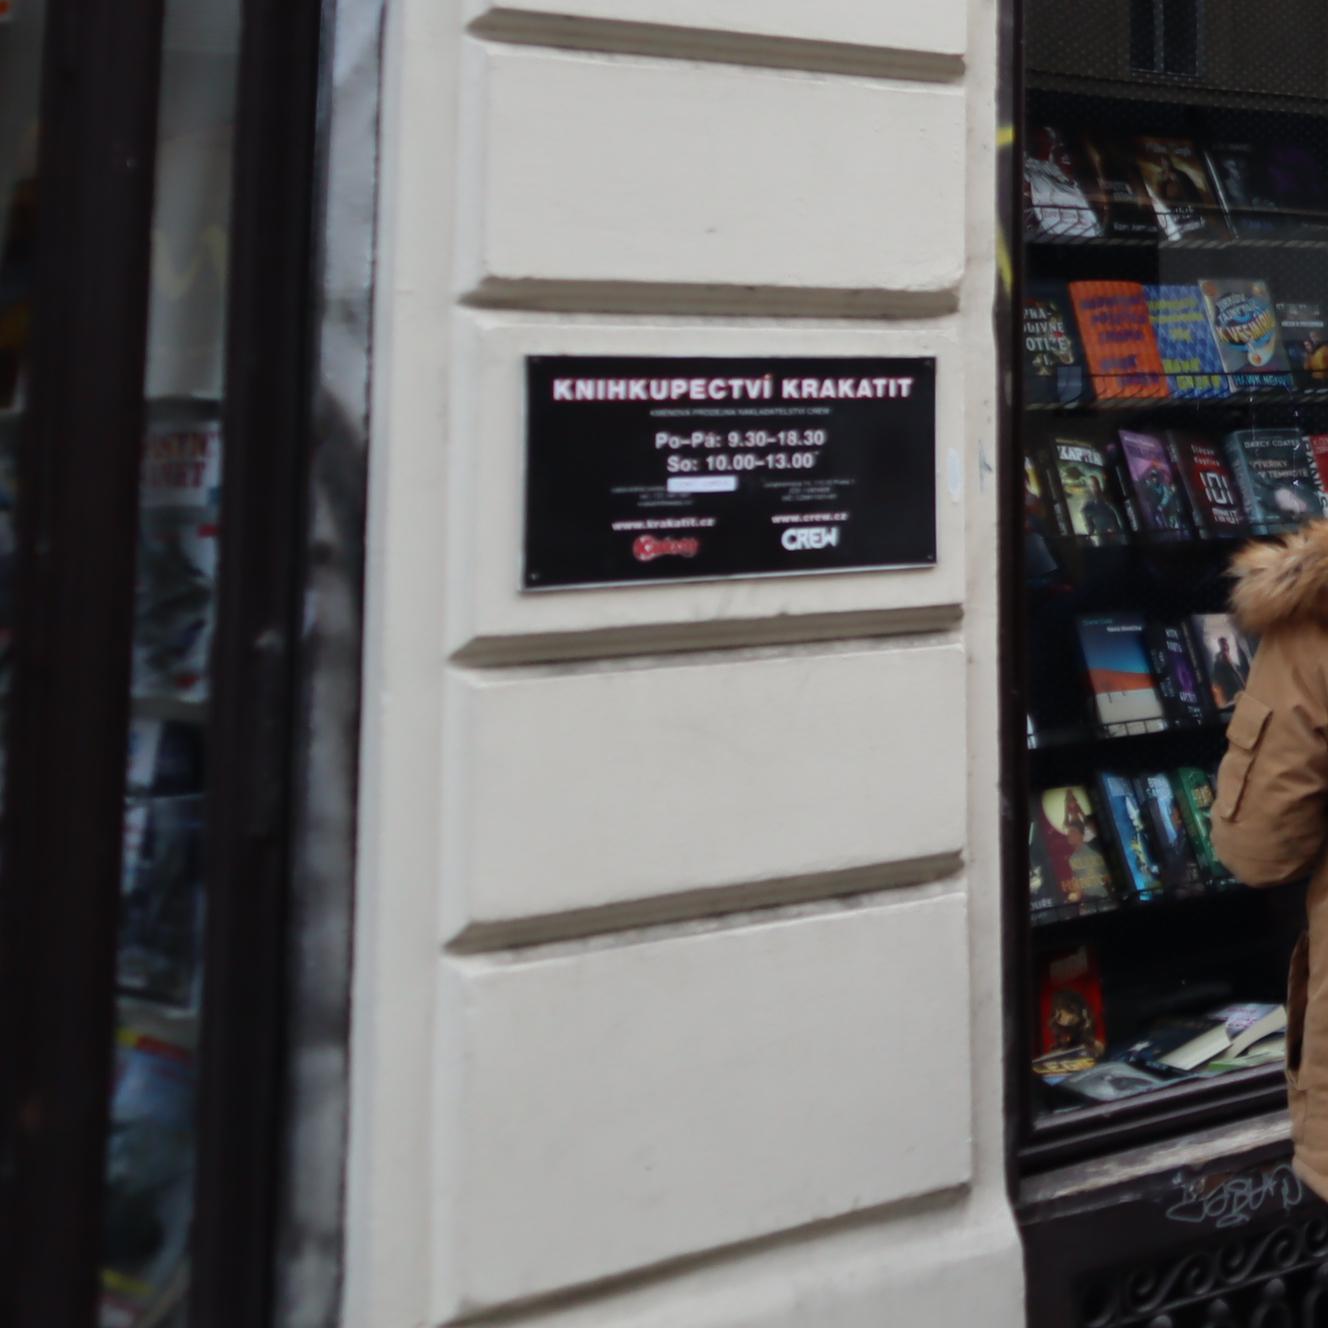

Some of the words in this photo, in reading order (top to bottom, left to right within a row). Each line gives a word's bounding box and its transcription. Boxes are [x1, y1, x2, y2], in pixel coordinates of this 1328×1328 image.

[552, 374, 773, 401] KNIHKUPECTVÍ
[781, 377, 914, 399] KRAKATIT
[1244, 440, 1270, 449] DARCY
[667, 455, 699, 474] So:
[612, 516, 716, 532] www.krakatit.cz
[771, 511, 850, 525] www.crew.cz
[781, 527, 839, 551] CREW
